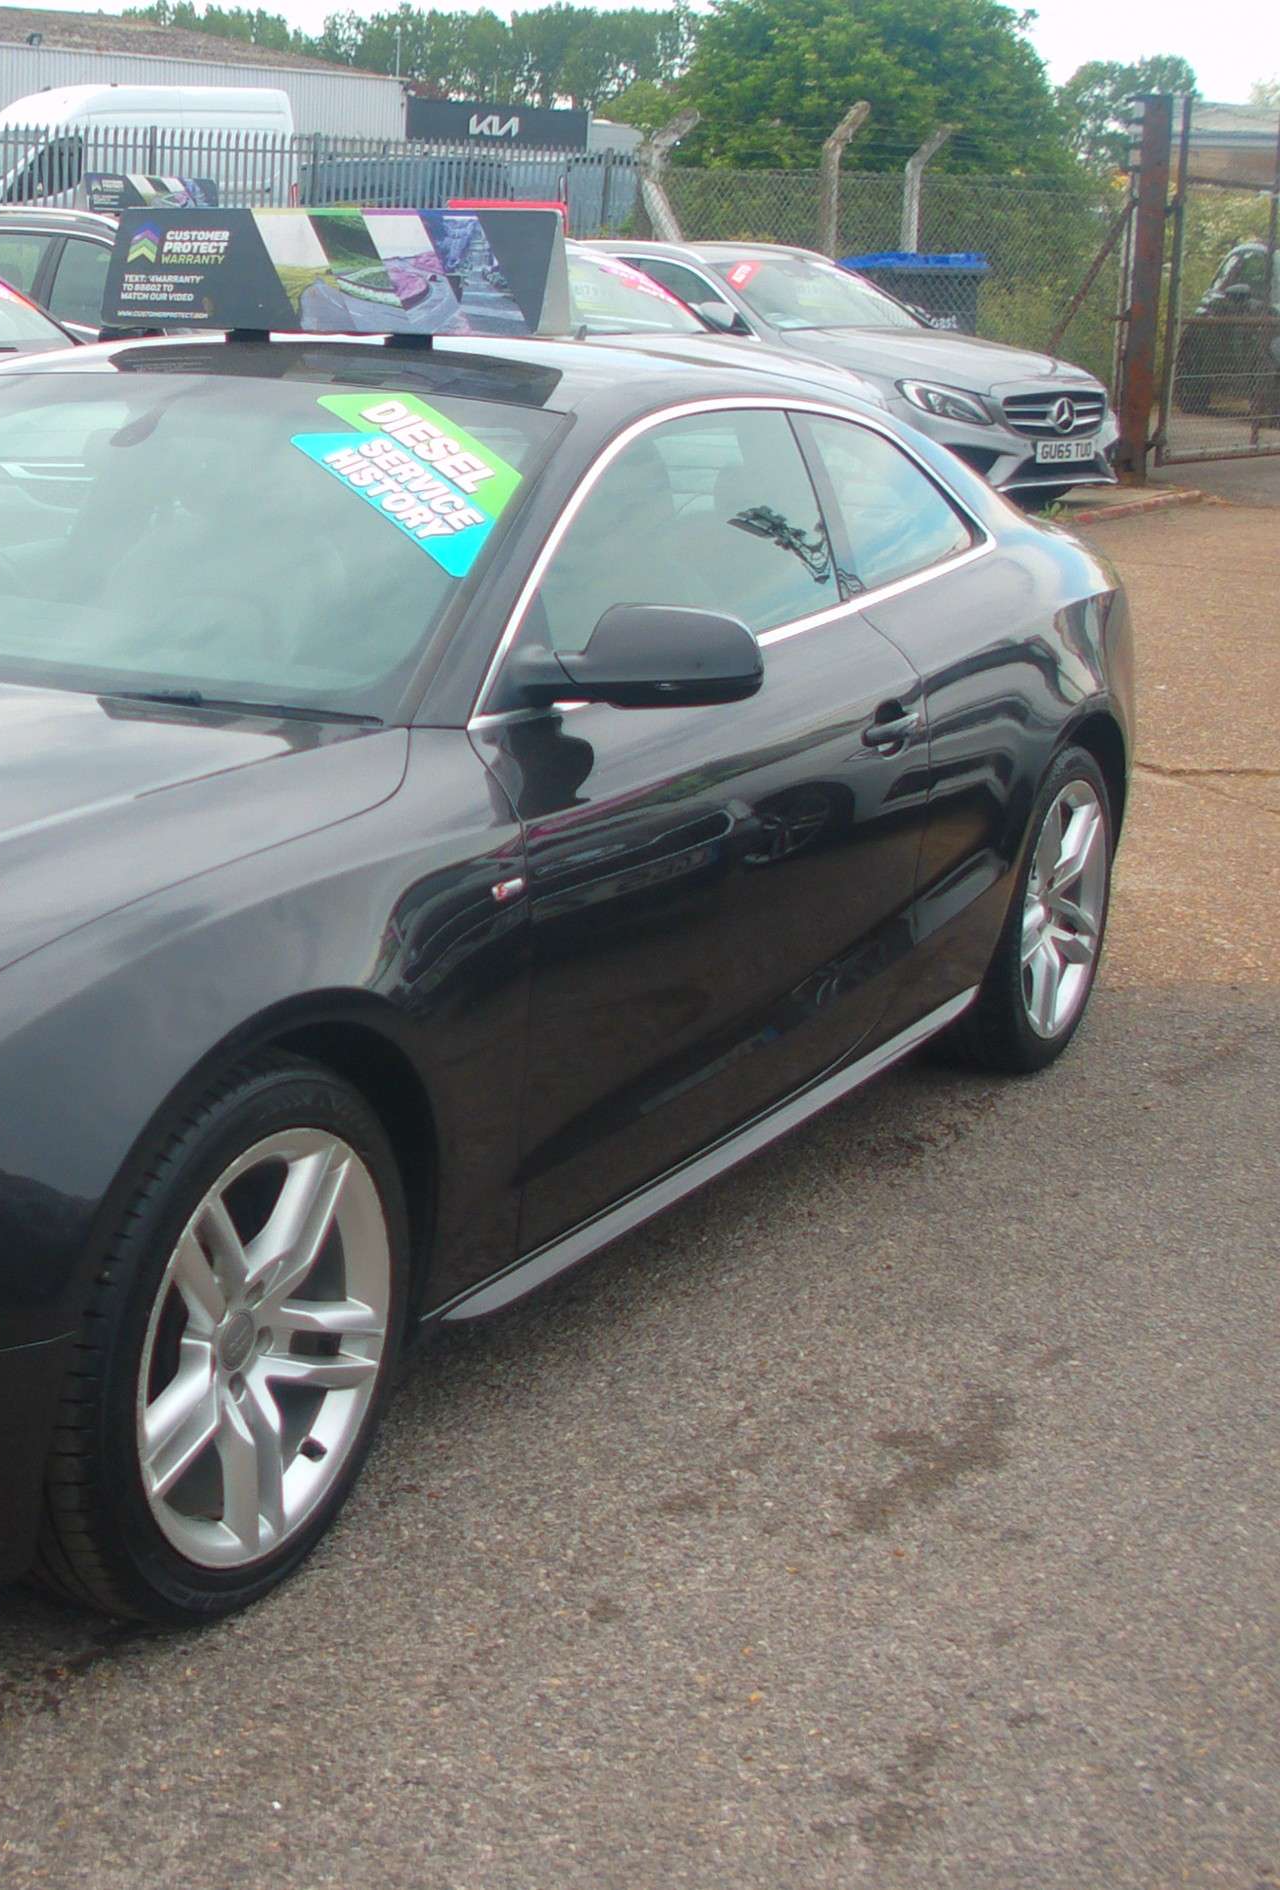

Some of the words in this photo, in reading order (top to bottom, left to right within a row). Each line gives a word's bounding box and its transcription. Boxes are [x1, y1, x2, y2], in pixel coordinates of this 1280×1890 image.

[469, 114, 519, 137] KIA
[163, 241, 228, 254] PROTECT
[166, 230, 230, 242] CUSTOMER
[161, 254, 225, 265] WARRANTY
[358, 400, 496, 495] DIESEL
[323, 448, 456, 540] HISTORY
[357, 438, 487, 532] SERVICE
